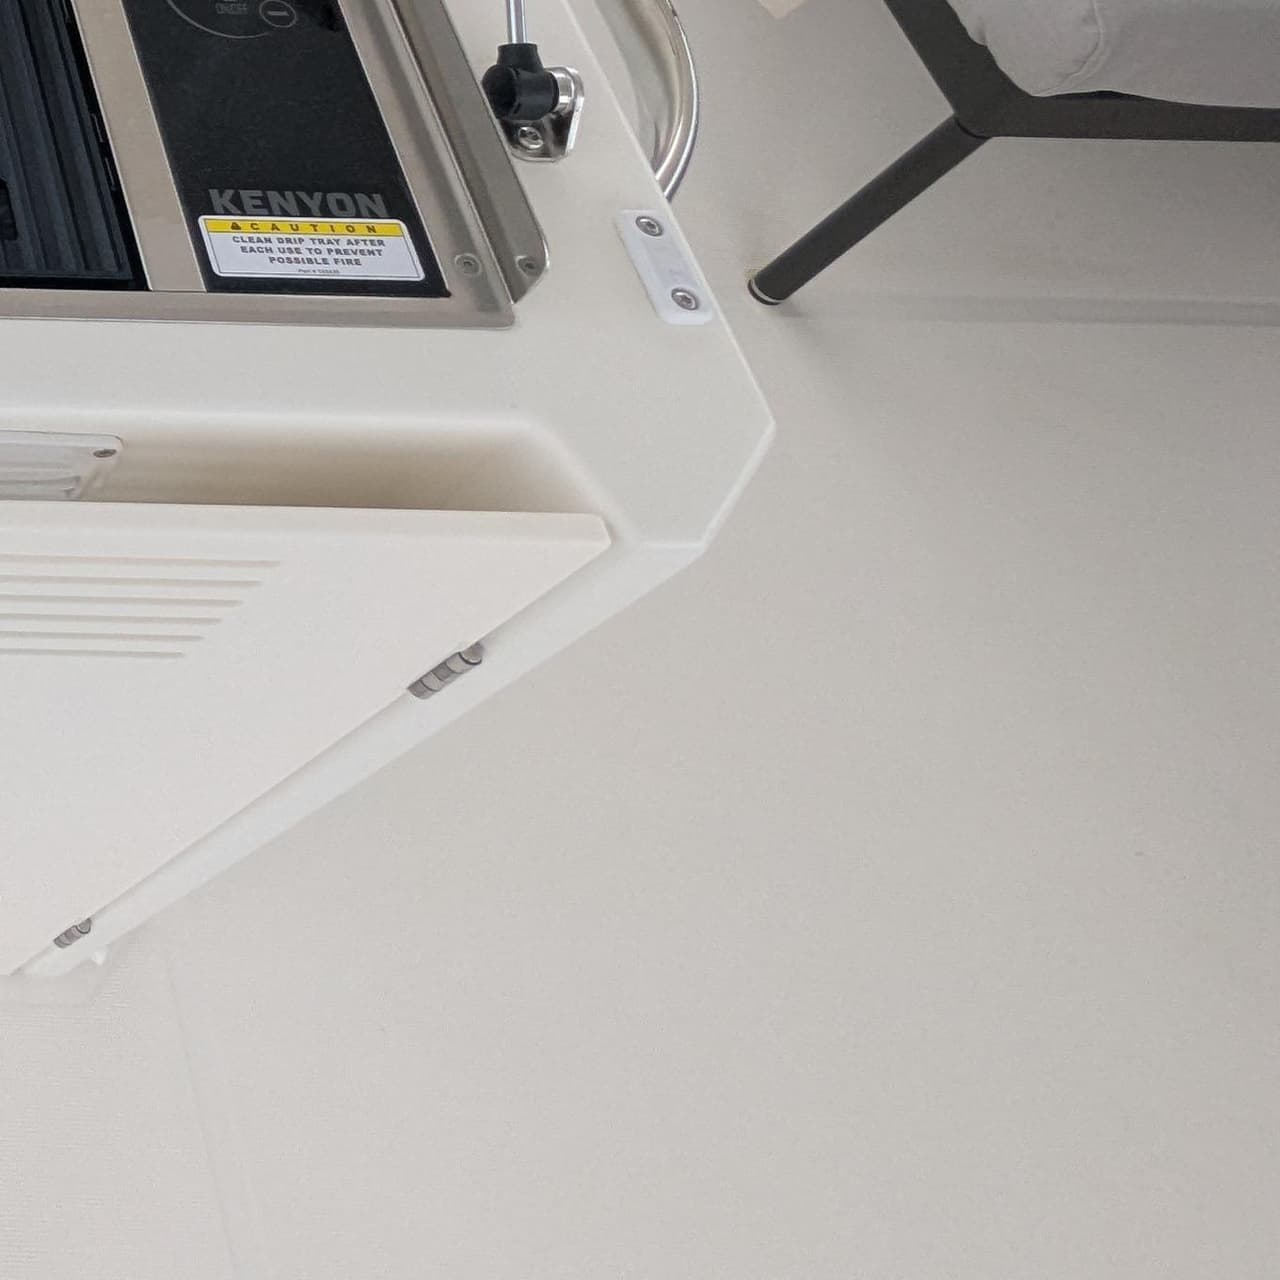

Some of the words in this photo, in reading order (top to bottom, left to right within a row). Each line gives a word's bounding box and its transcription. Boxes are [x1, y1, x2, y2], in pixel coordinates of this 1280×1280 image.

[208, 189, 389, 218] KENYON
[250, 222, 377, 234] CAUTION
[232, 235, 273, 244] CLEAN
[276, 237, 305, 245] DRIP
[308, 237, 341, 246] TRAY
[346, 238, 386, 247] AFTER
[240, 246, 274, 254] EACH
[278, 247, 303, 255] USE
[305, 247, 322, 255] TO
[326, 248, 383, 257] PREVENT
[268, 256, 330, 265] POSSIBLE
[333, 258, 362, 266] FIRE
